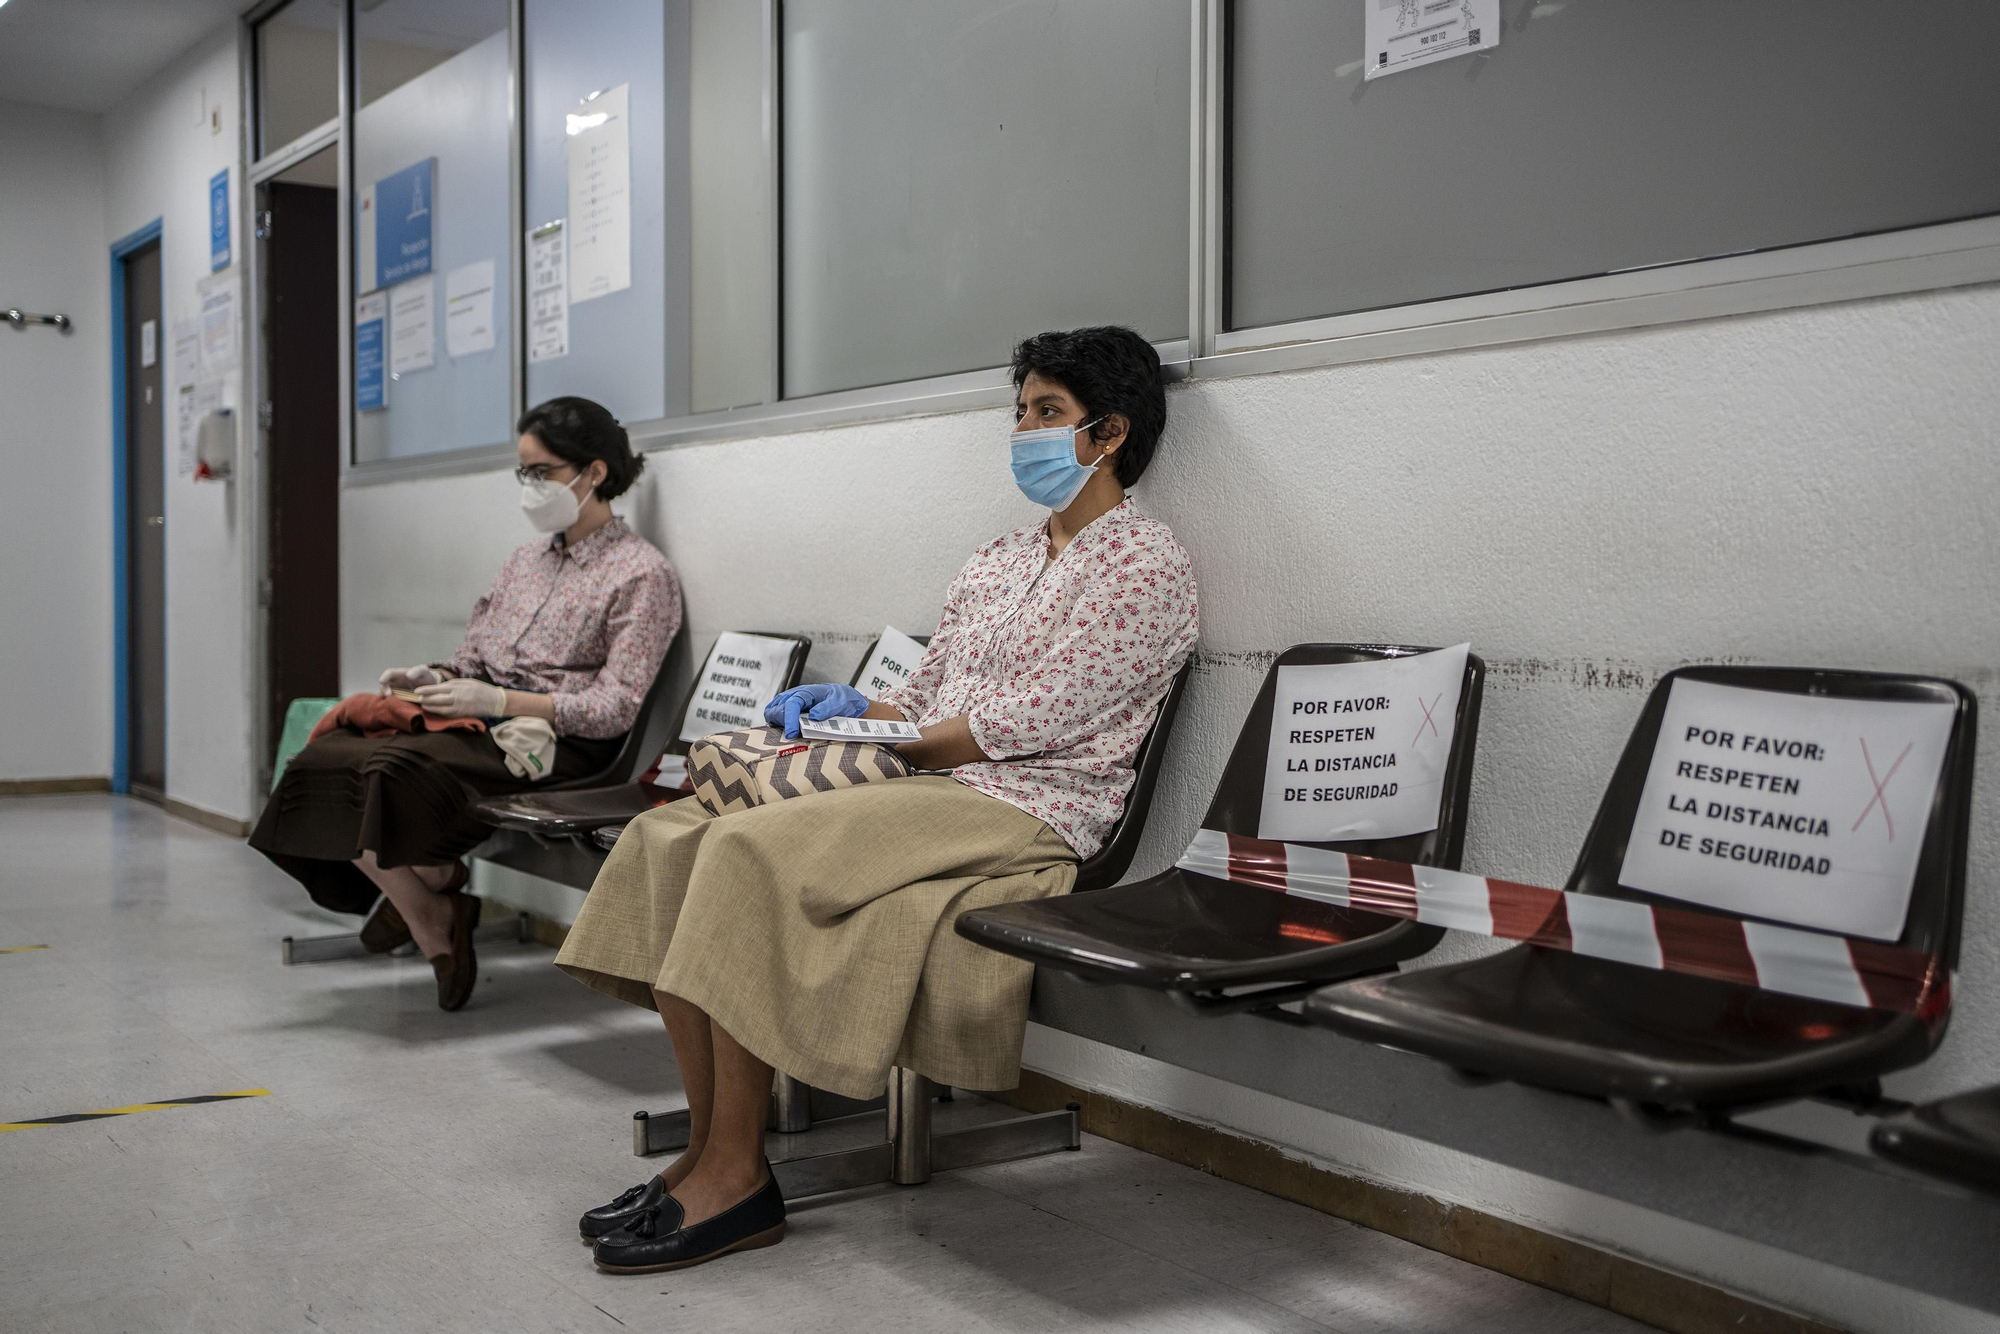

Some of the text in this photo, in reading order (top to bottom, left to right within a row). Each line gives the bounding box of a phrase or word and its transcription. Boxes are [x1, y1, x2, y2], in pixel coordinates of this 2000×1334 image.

[717, 654, 735, 665] POR
[881, 656, 902, 675] POR
[711, 672, 751, 688] RESPETEN
[703, 690, 714, 700] LA
[696, 708, 708, 720] DE
[1292, 696, 1390, 715] POR FAVOR:
[1289, 726, 1376, 744] RESPETEN
[1685, 726, 1825, 762] POR FAVOR:
[1286, 753, 1397, 772] LA DISTANCIA
[1676, 760, 1800, 796] RESPETEN
[1283, 782, 1398, 802] DE SEGURIDAD
[1667, 794, 1830, 837] LA DISTANCIA
[1659, 828, 1832, 876] DE SEGURIDAD
